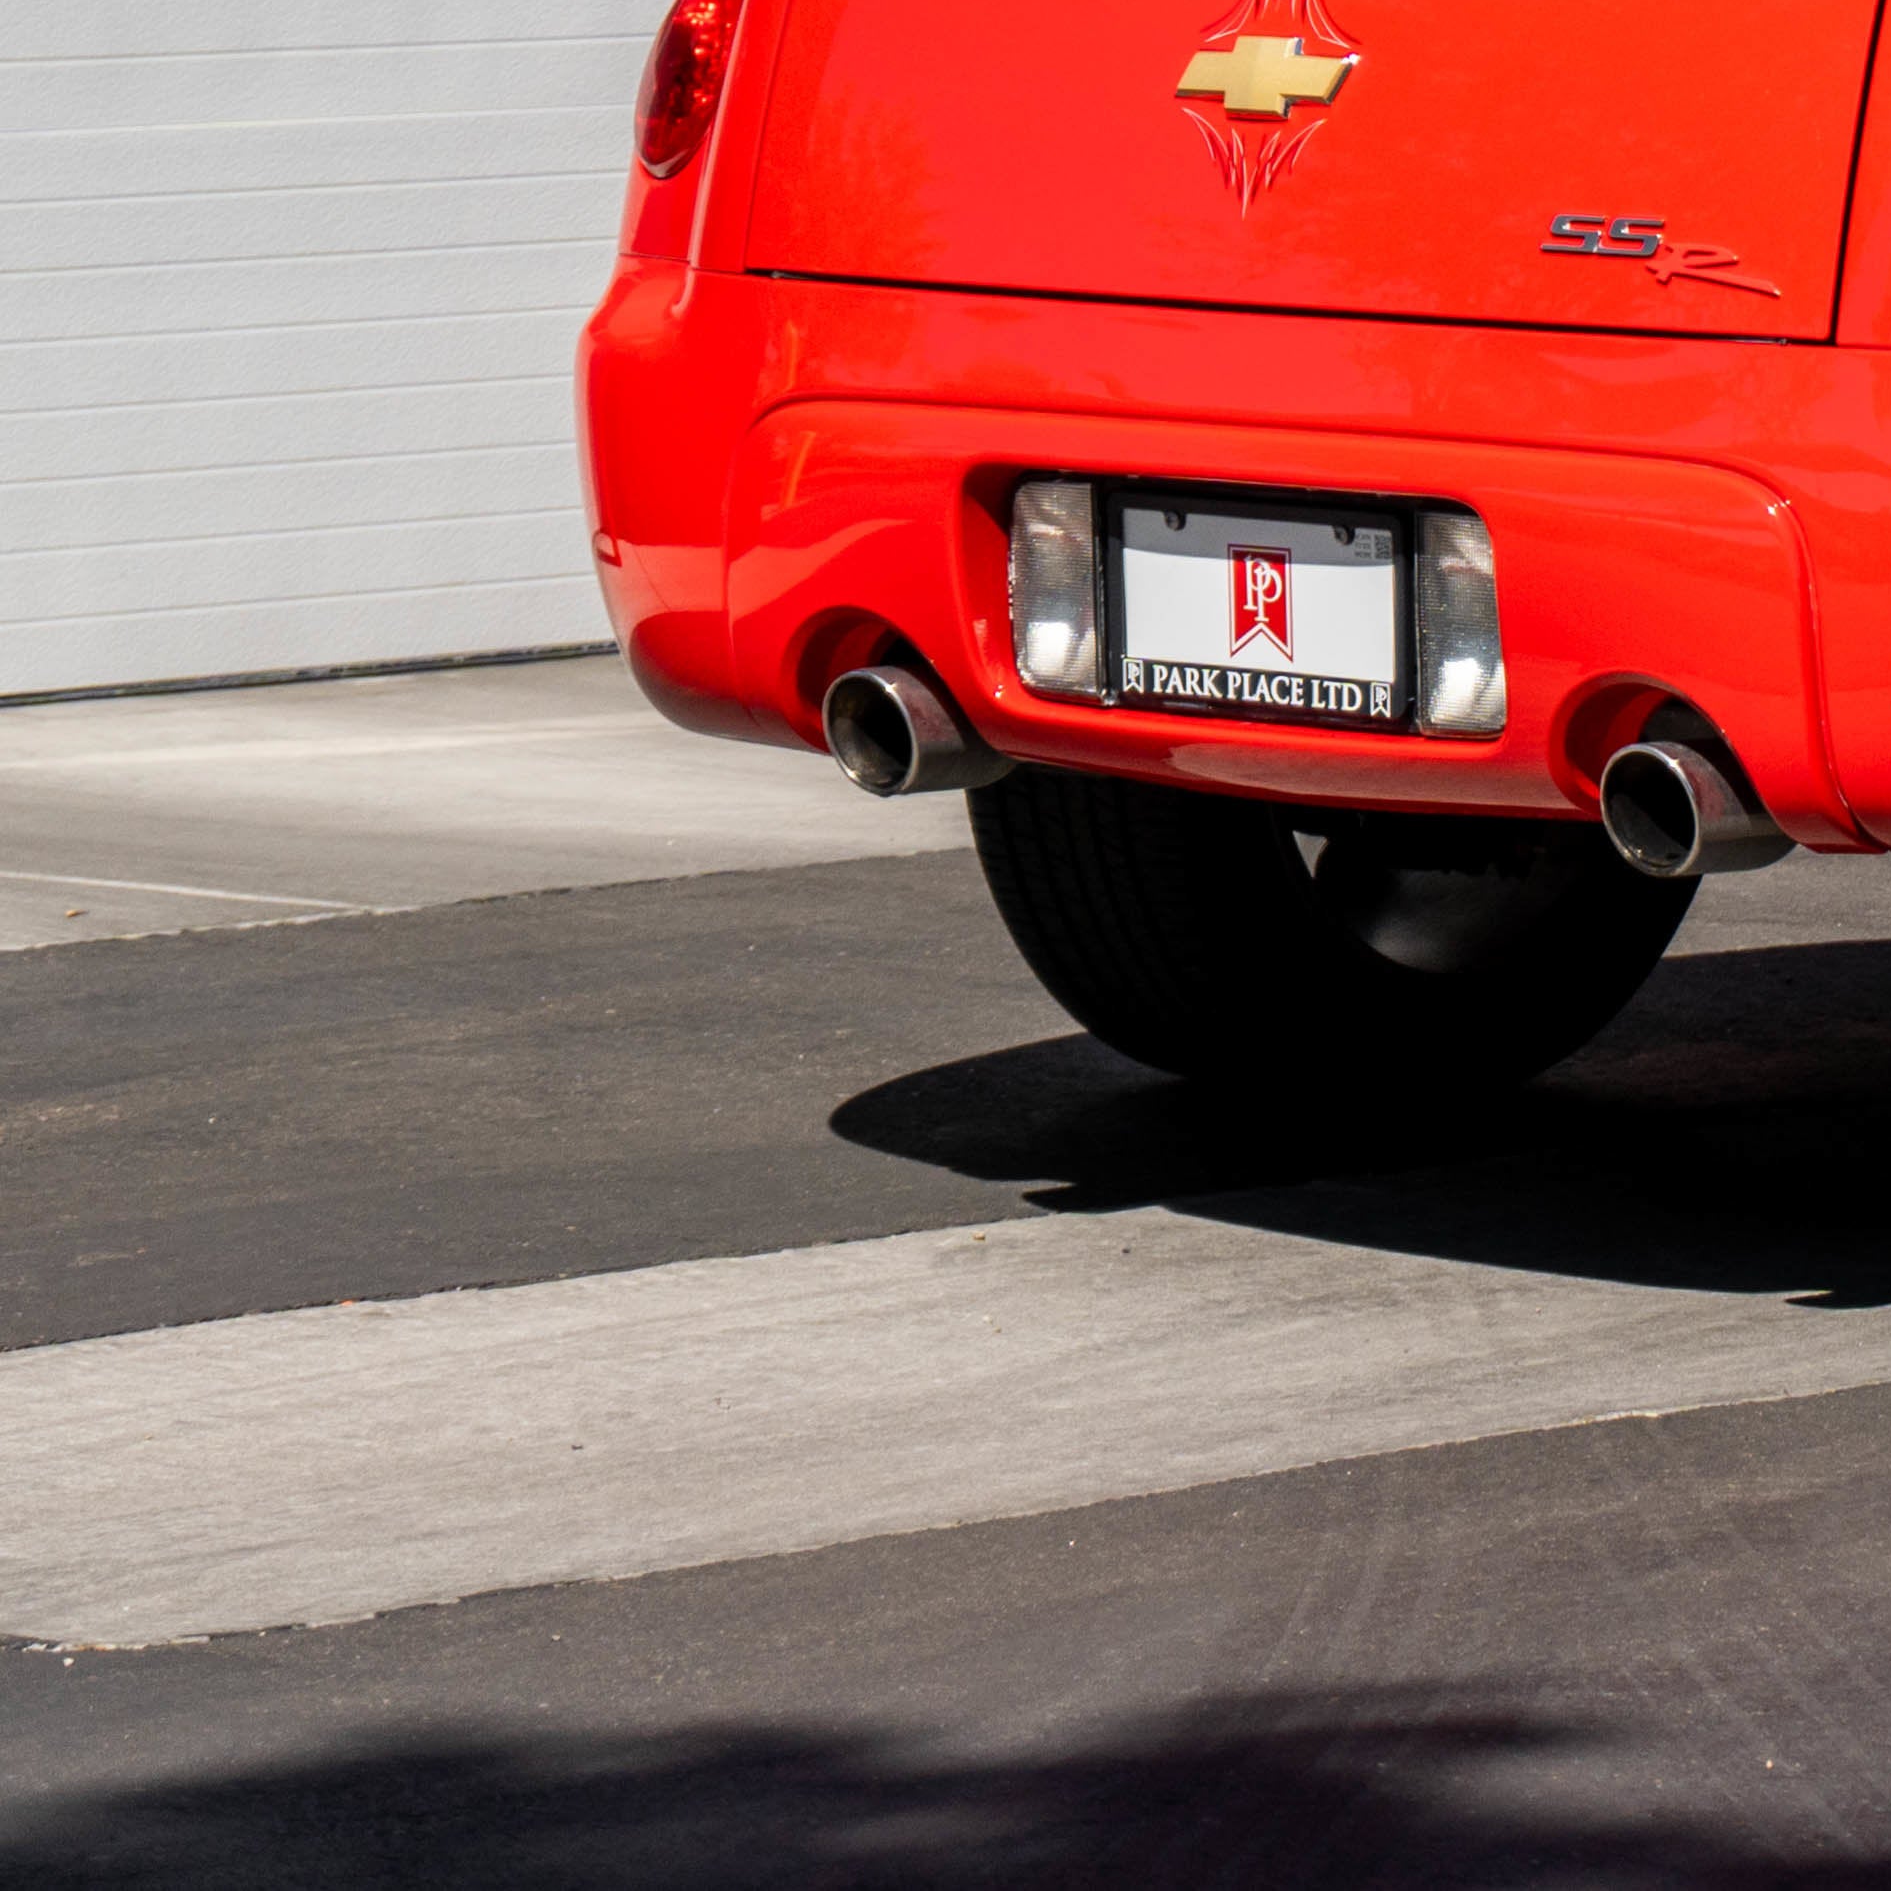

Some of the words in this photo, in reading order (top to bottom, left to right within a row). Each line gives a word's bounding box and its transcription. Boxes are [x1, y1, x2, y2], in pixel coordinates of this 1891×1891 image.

[1539, 214, 1782, 298] SSR
[1153, 664, 1222, 696] PARK
[1226, 670, 1304, 706] PLACE
[1310, 676, 1362, 712] LTD
